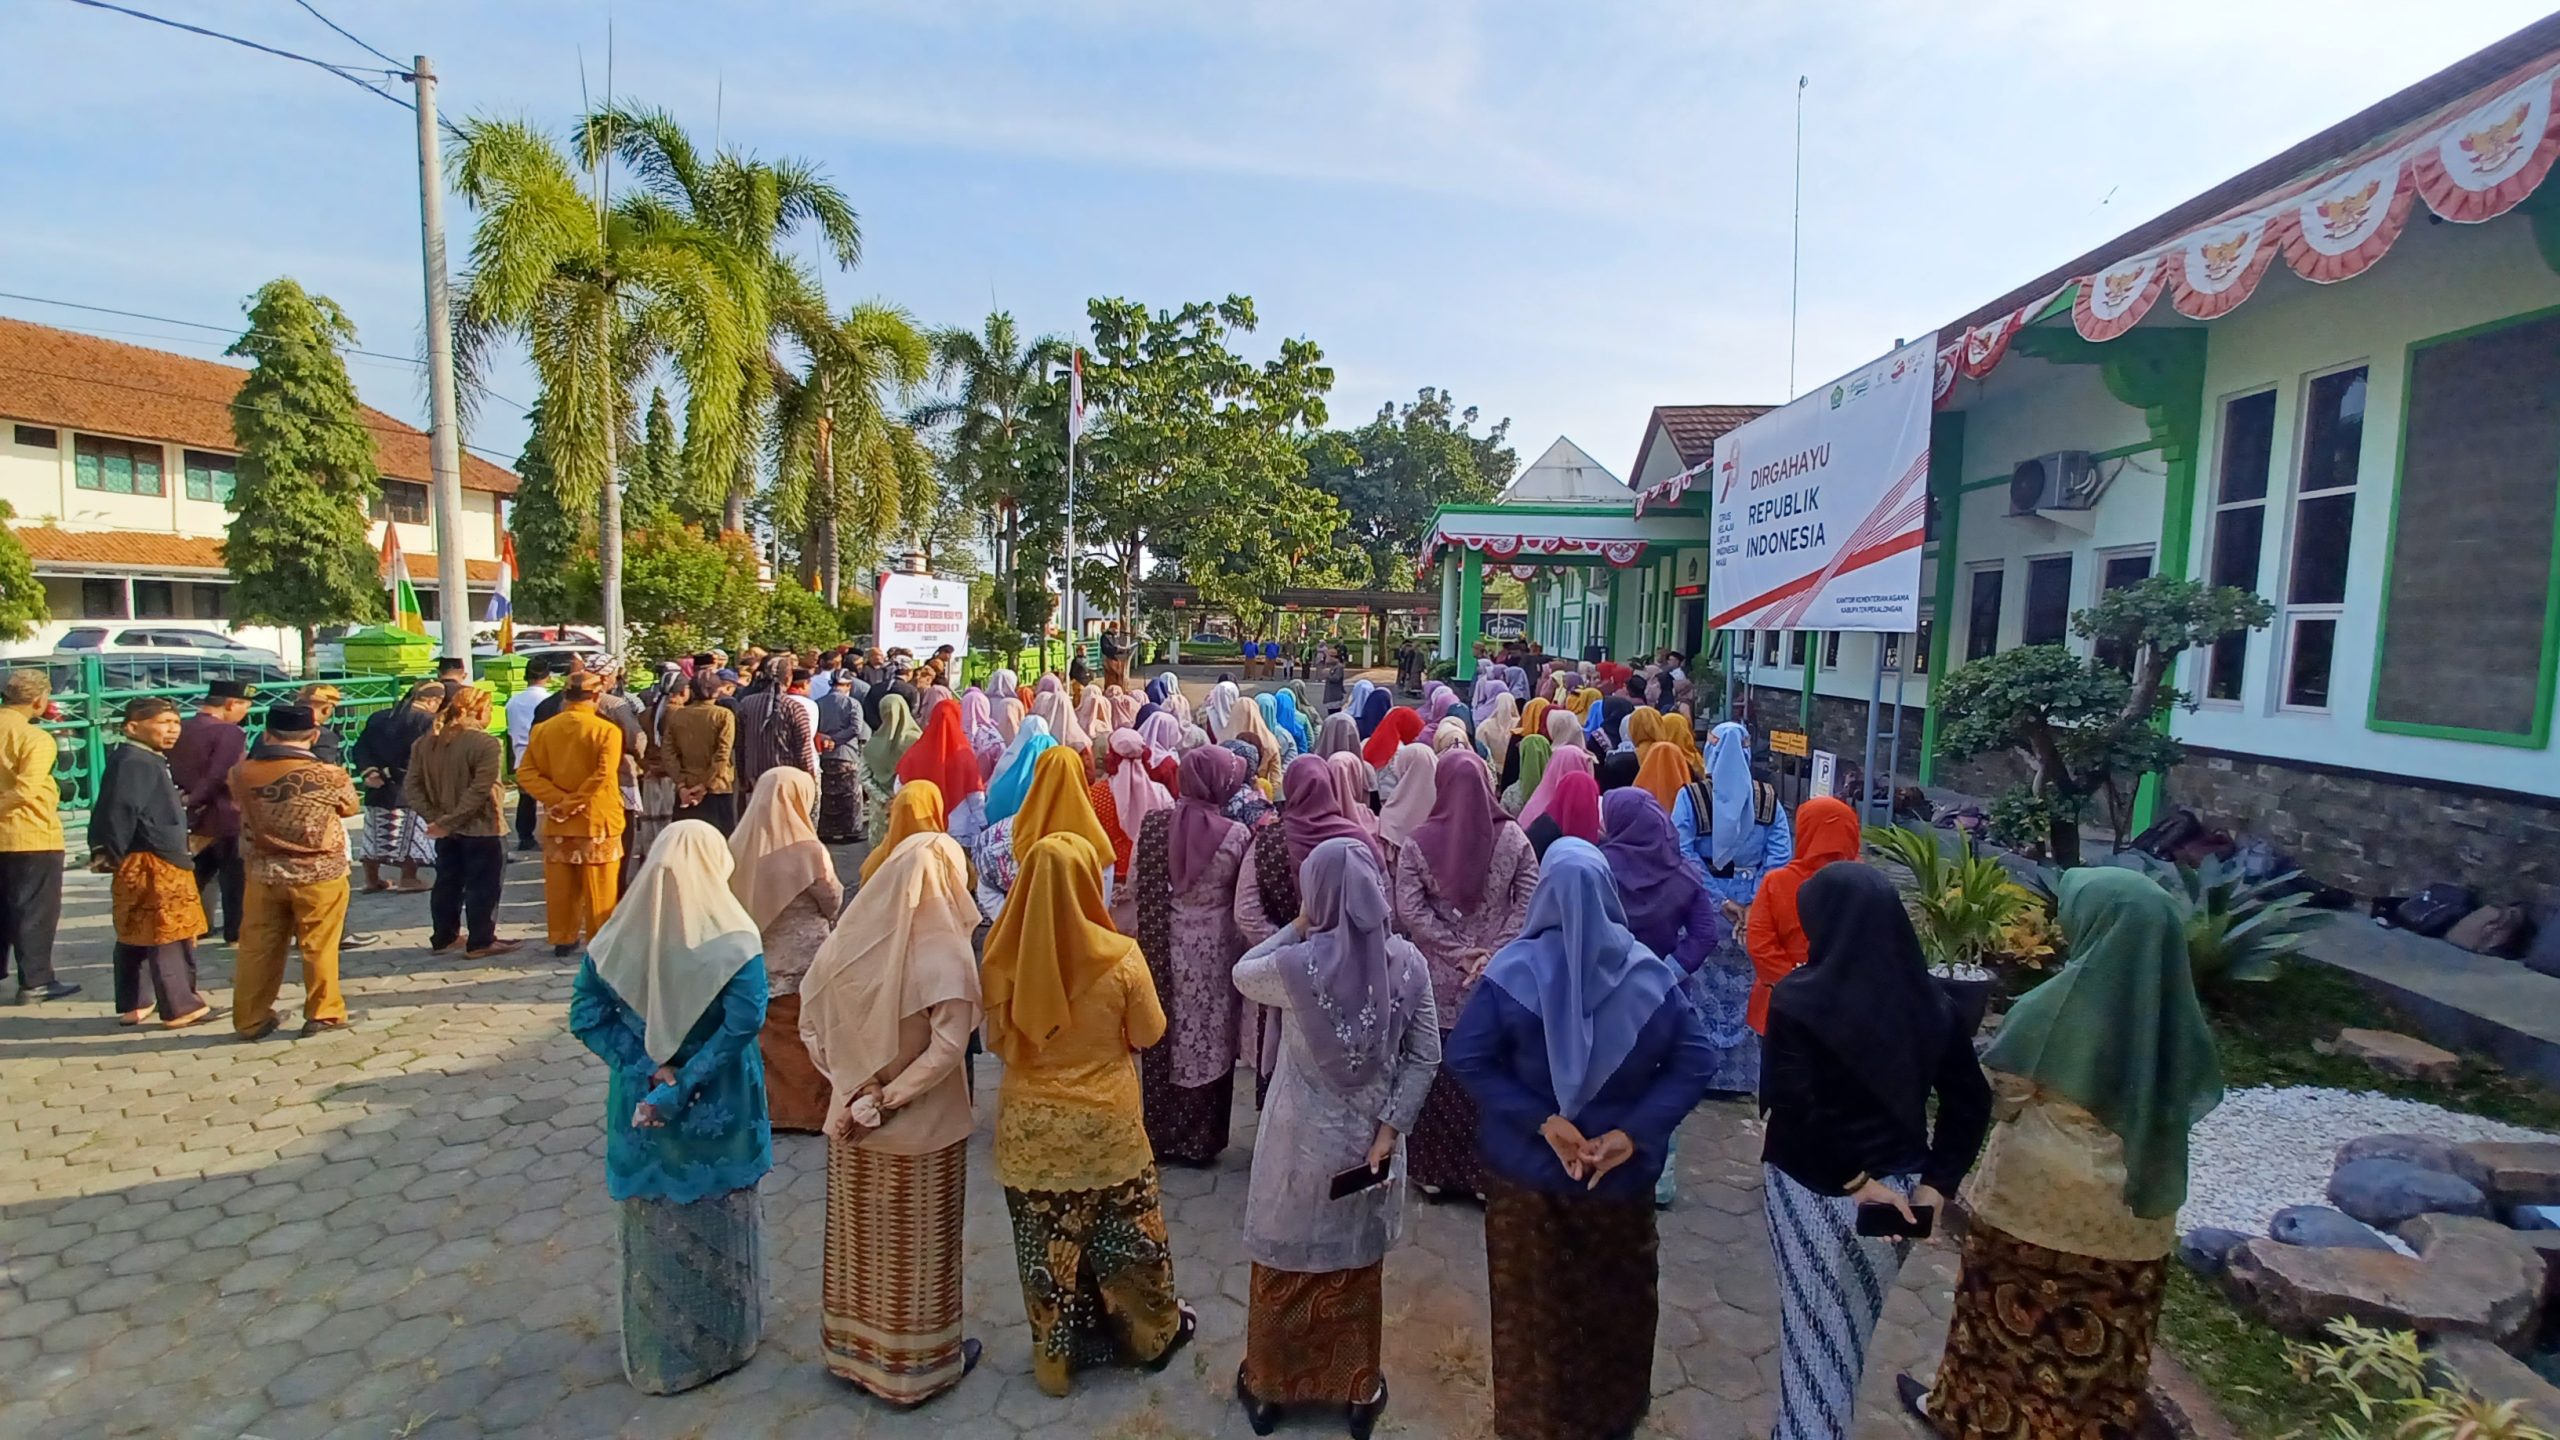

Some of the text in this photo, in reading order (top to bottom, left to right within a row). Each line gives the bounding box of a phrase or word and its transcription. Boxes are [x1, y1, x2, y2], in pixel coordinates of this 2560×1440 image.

[1750, 442, 1831, 491] DIRGAHAYU
[1748, 486, 1820, 526] REPUBLIK
[1746, 522, 1826, 559] INDONESIA
[1889, 594, 1910, 602] AGAMA
